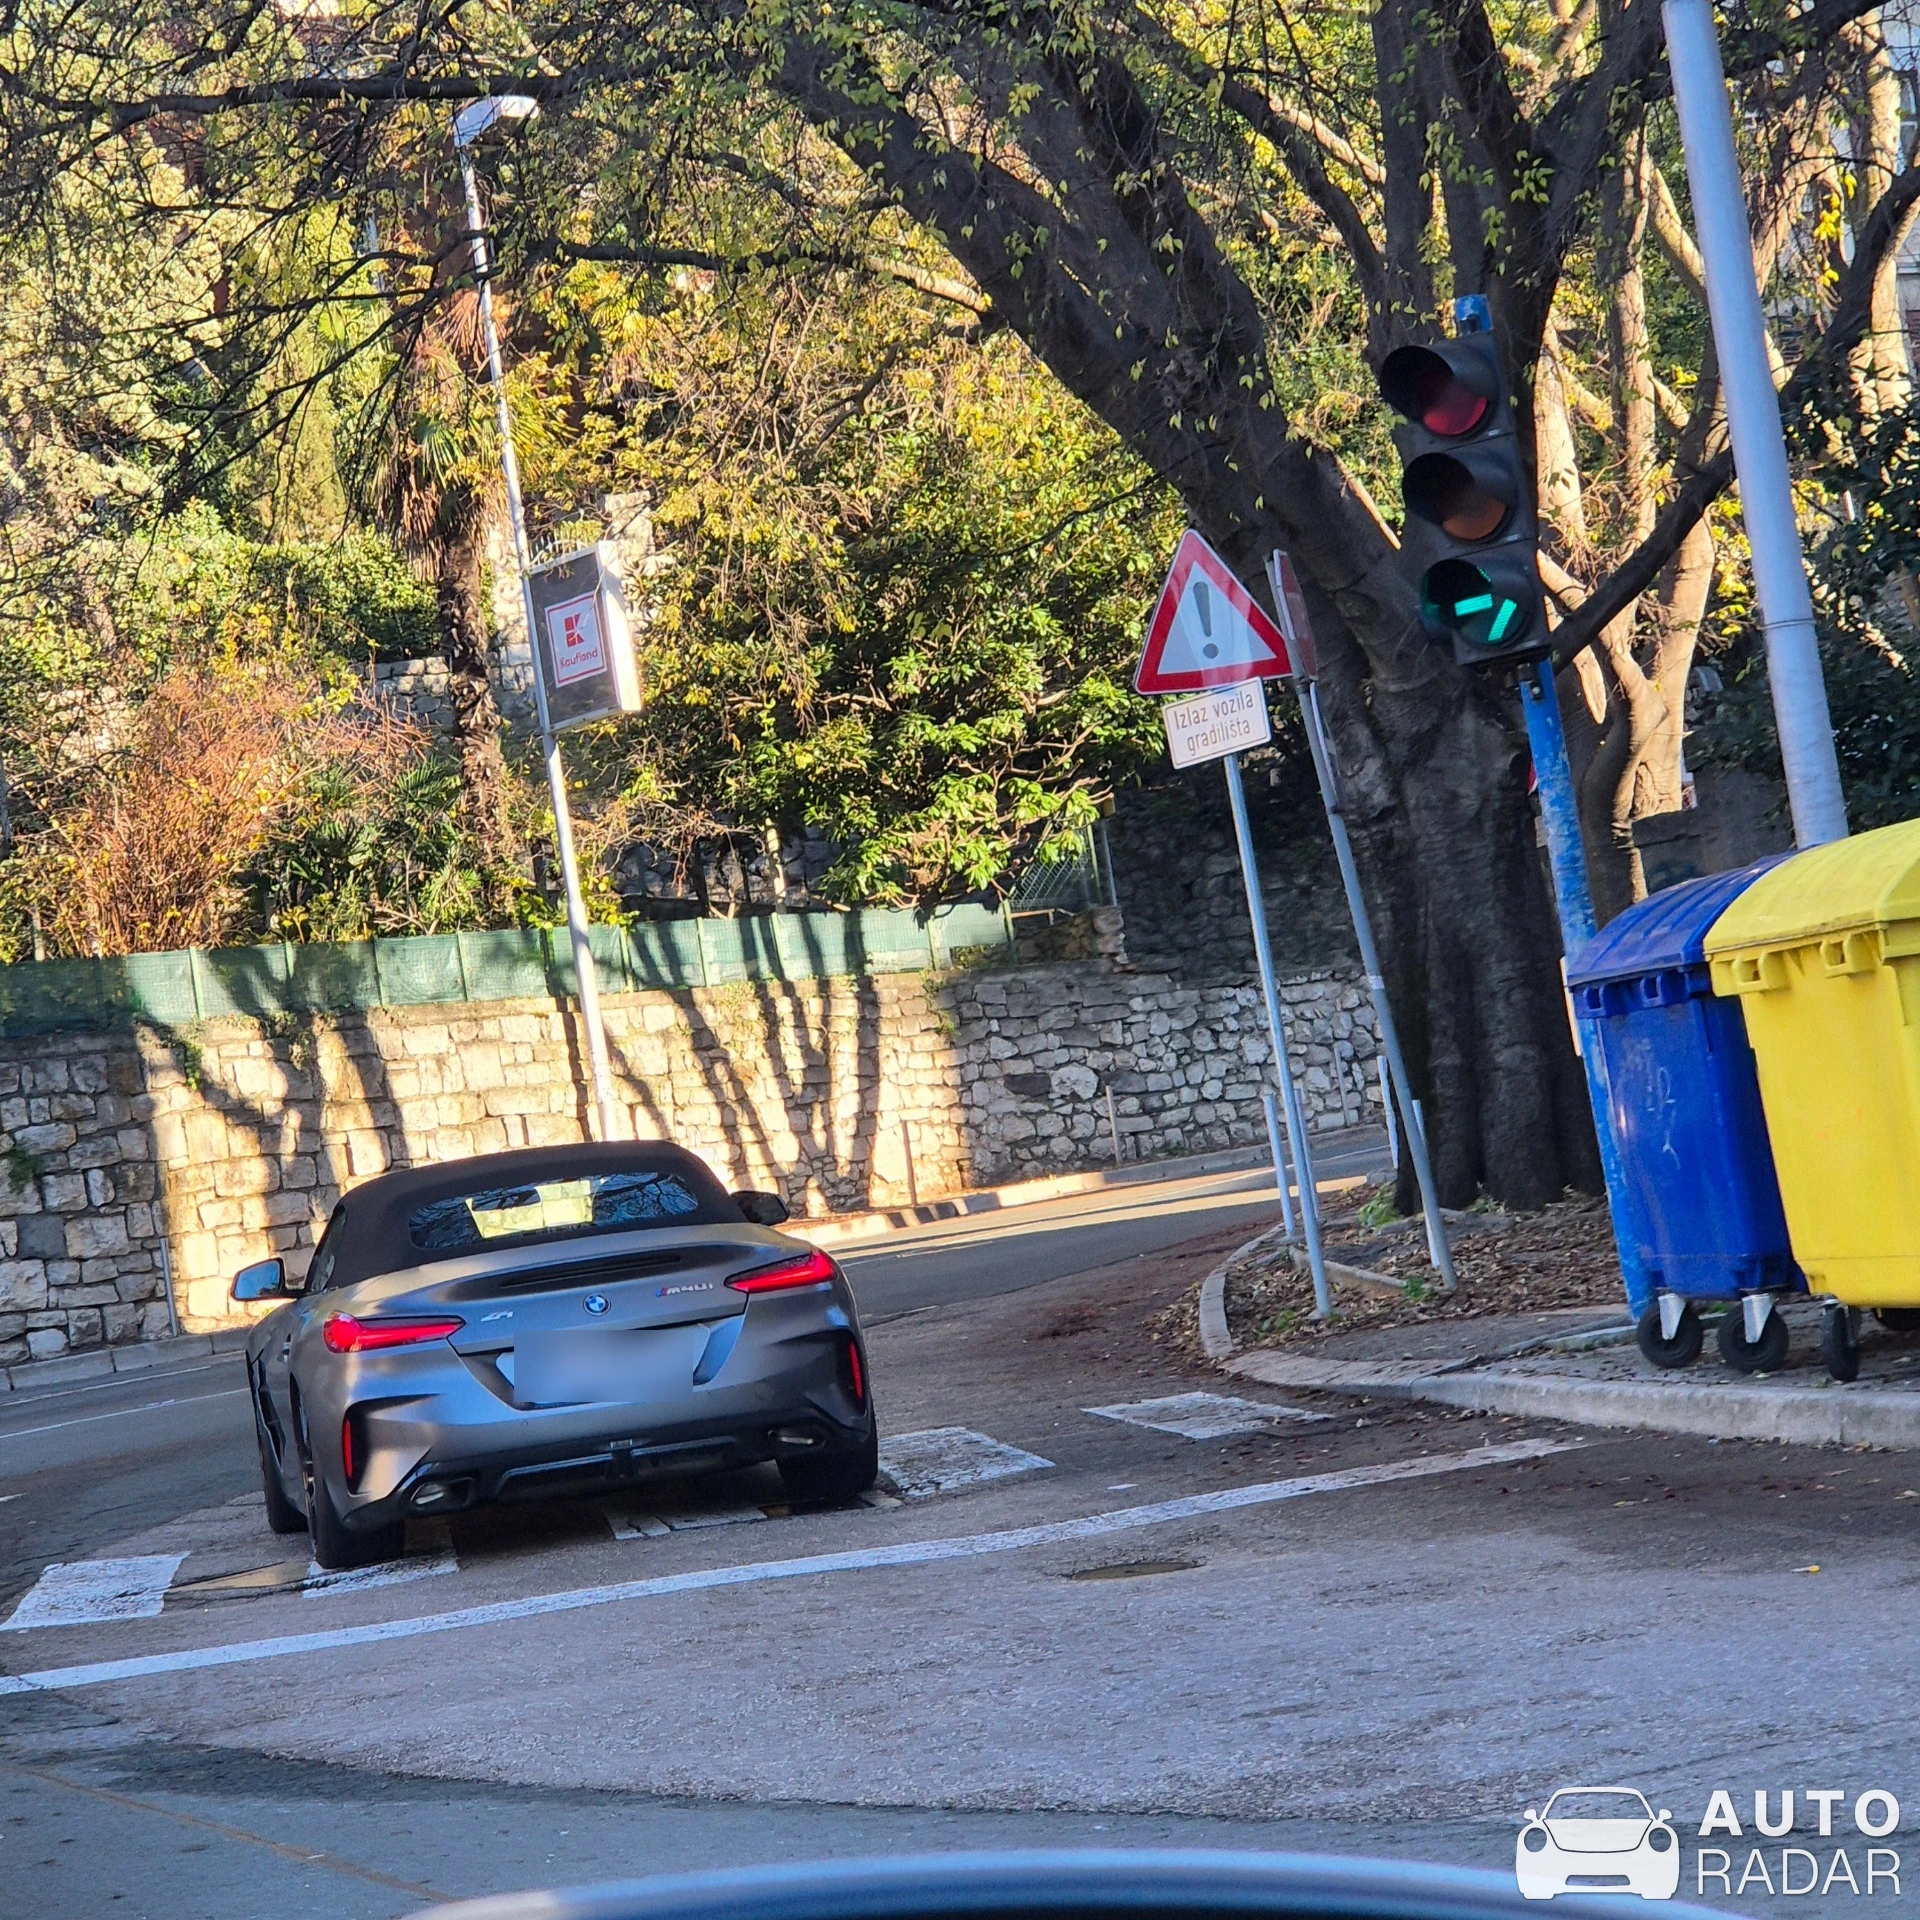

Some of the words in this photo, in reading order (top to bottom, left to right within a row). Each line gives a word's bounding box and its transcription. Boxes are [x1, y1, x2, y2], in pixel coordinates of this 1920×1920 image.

[560, 647, 598, 669] Kaufland
[1174, 707, 1208, 730] Izlaz
[1213, 690, 1254, 718] vozila
[1187, 717, 1251, 757] gradilišta
